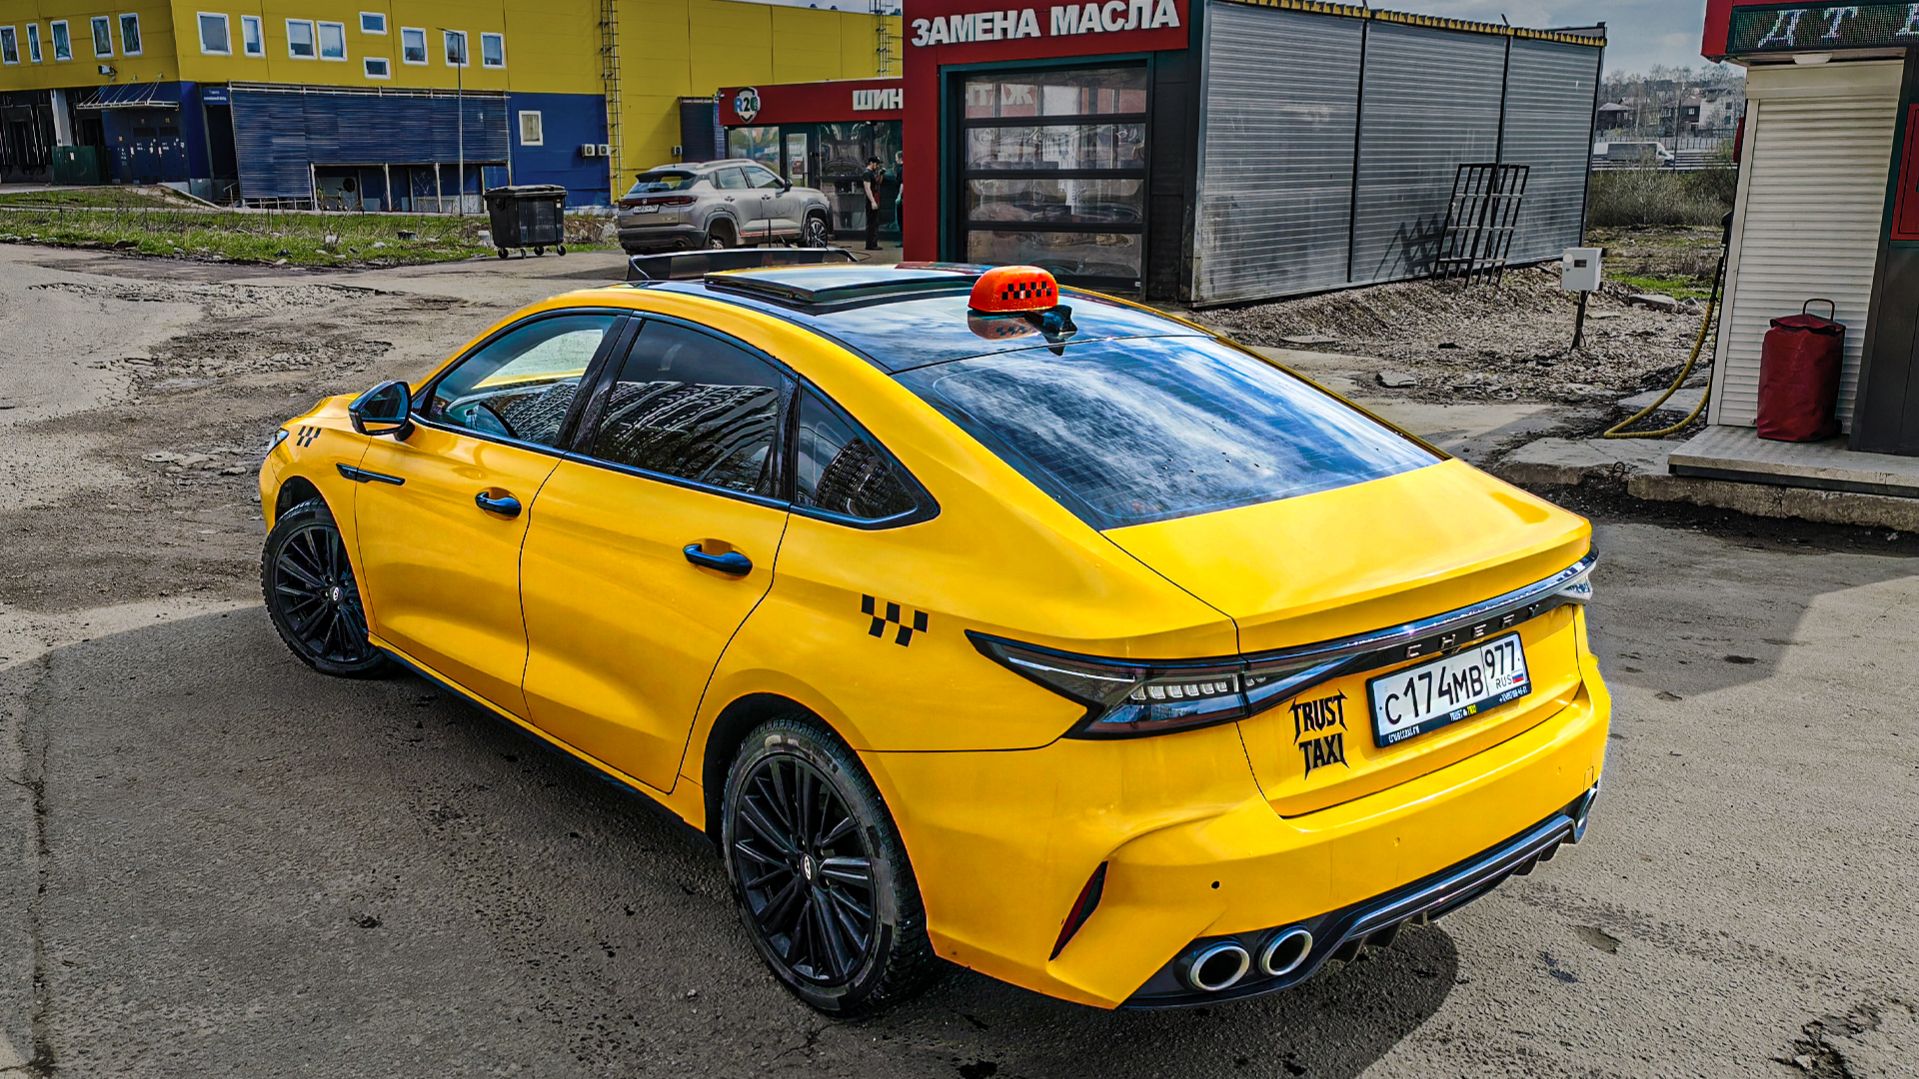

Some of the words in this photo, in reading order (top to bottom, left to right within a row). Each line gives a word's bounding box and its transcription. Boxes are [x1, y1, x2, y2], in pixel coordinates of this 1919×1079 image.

[911, 8, 1041, 47] ЗАМЕНА
[1050, 0, 1180, 36] МАСЛА
[1406, 604, 1540, 659] CHERY
[1485, 640, 1516, 680] 977
[1495, 673, 1512, 690] RUS
[1288, 688, 1348, 745] TRUST
[1299, 733, 1350, 780] TAXI
